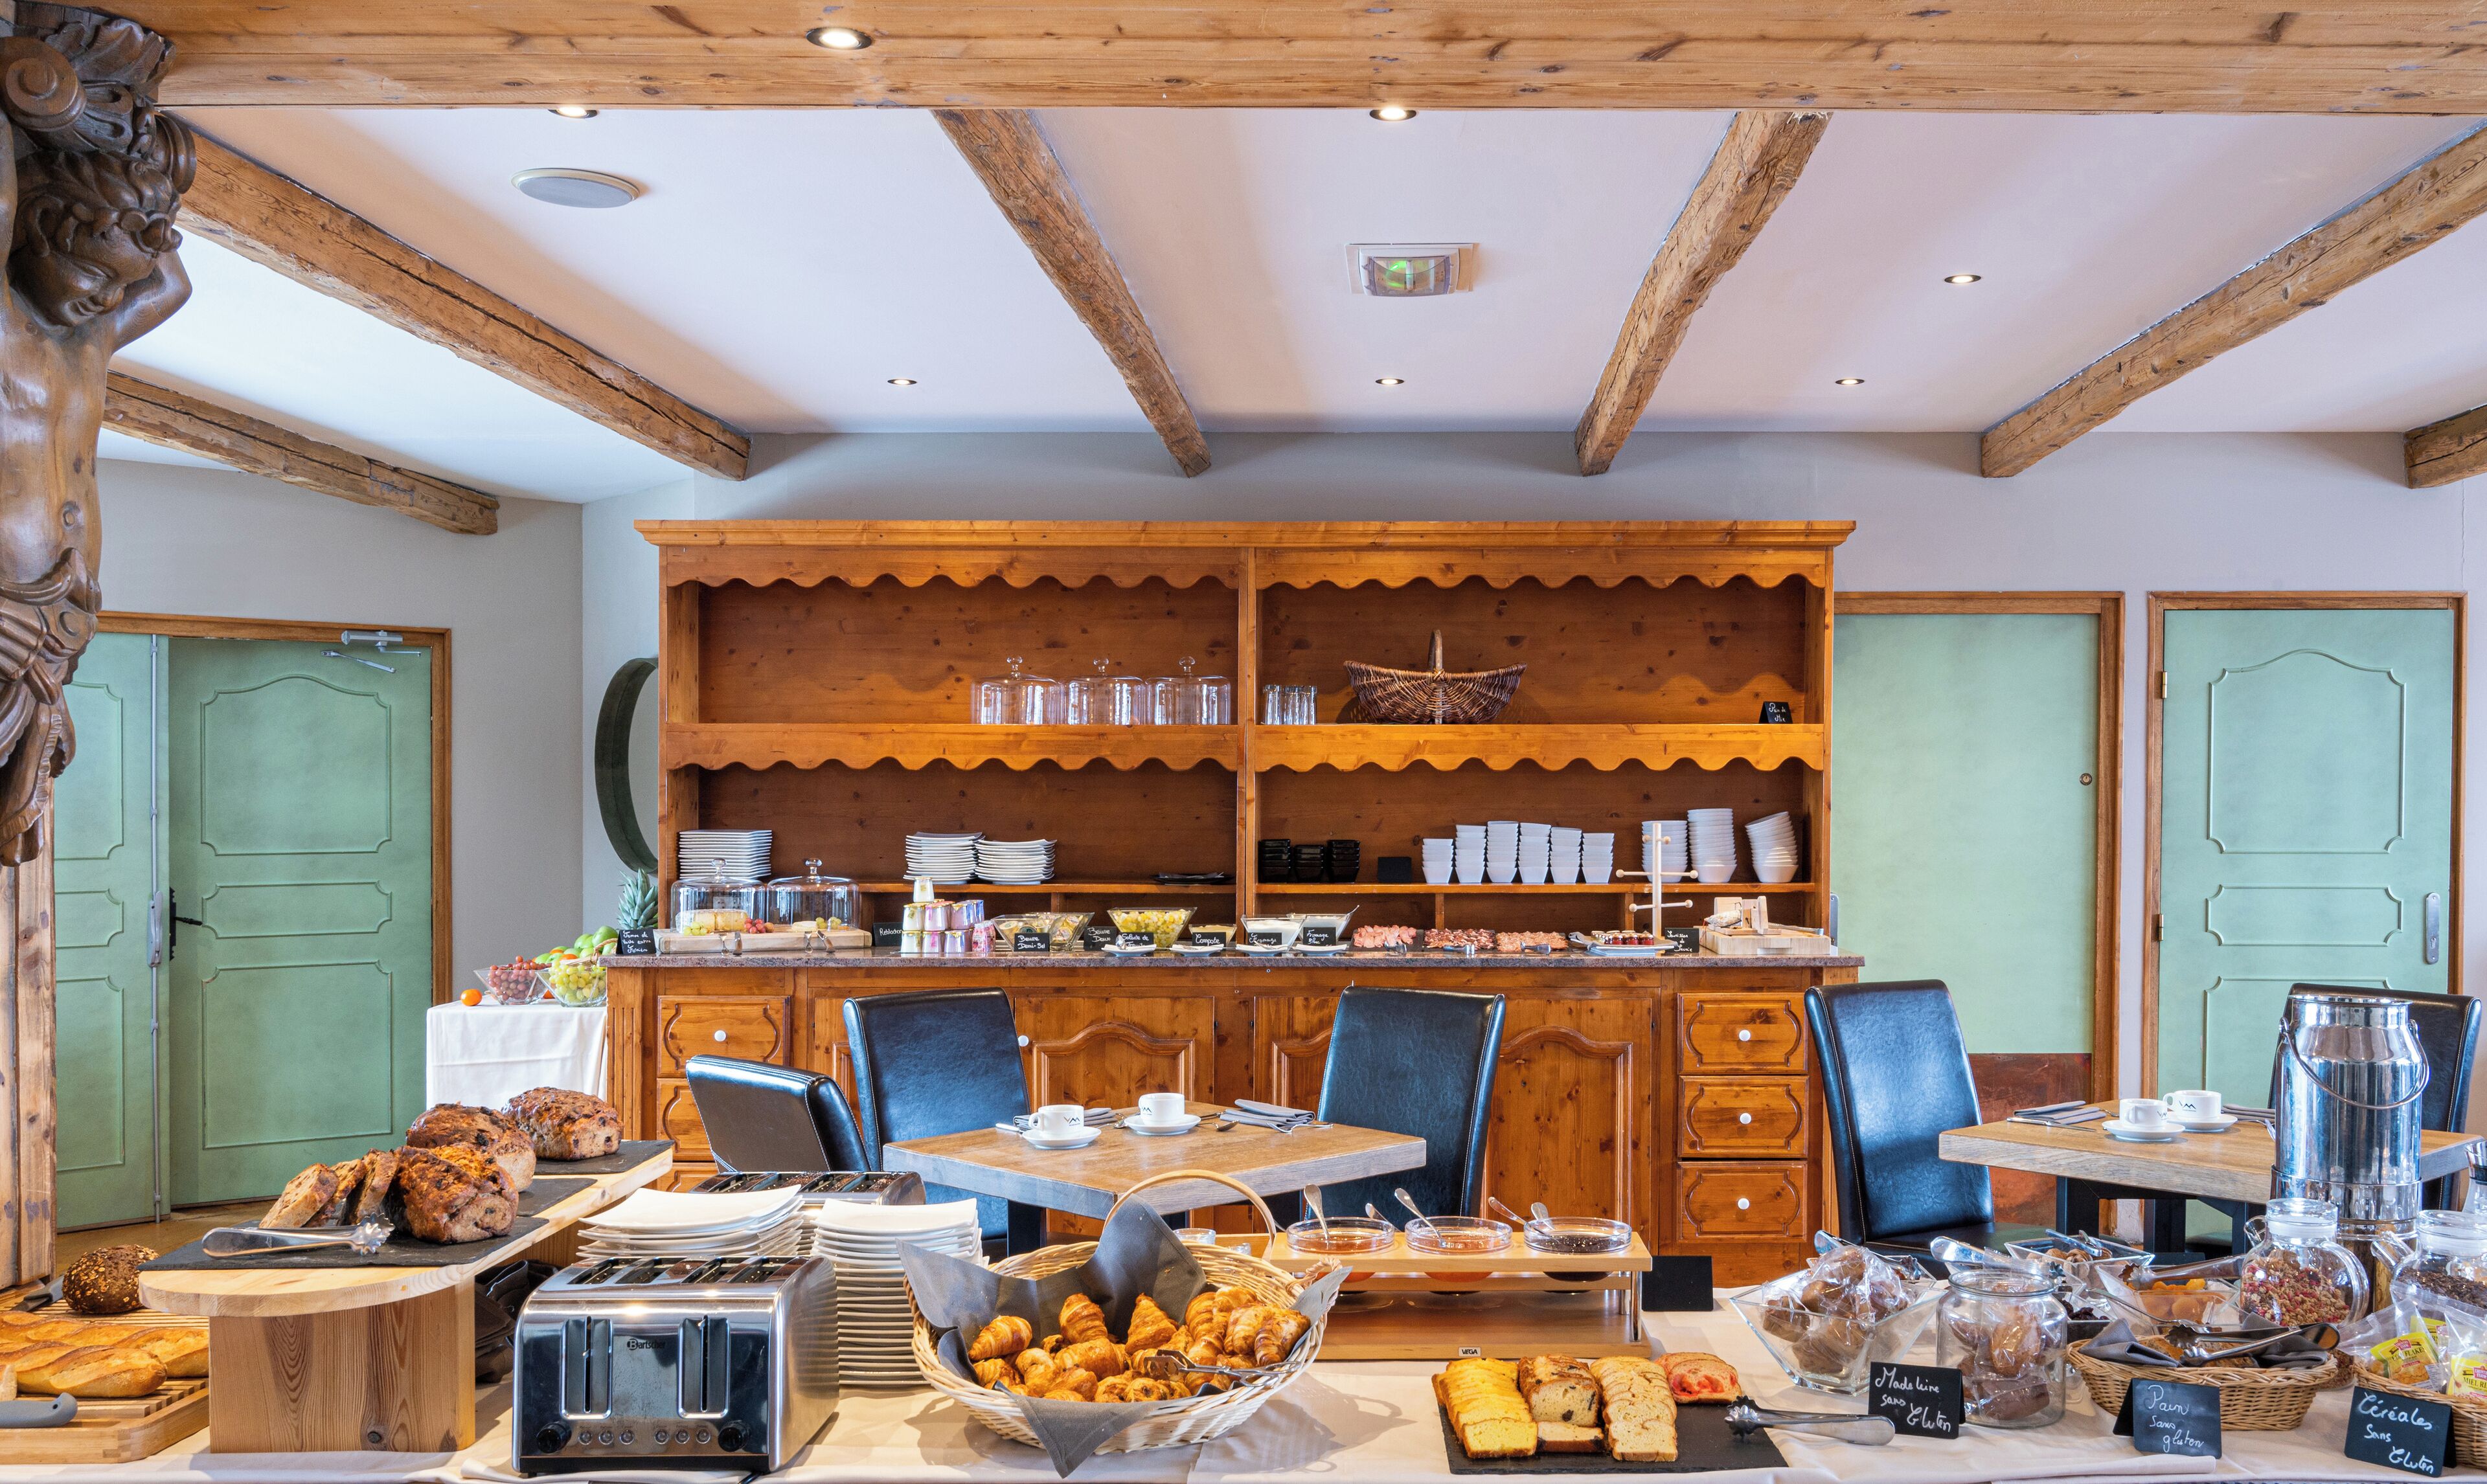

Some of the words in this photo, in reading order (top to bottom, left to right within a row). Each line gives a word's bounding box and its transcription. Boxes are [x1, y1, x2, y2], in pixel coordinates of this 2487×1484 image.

[1769, 703, 1780, 712] Pain
[1087, 927, 1111, 936] Beurre
[1195, 933, 1220, 946] Compote
[1306, 929, 1329, 941] Fromage
[626, 1338, 666, 1351] Bartscher
[2148, 1384, 2189, 1415] Pain
[1907, 1402, 1951, 1432] Gluten
[2358, 1392, 2433, 1430] Céréales
[2163, 1429, 2205, 1453] gluten
[2388, 1446, 2435, 1474] Gluten
